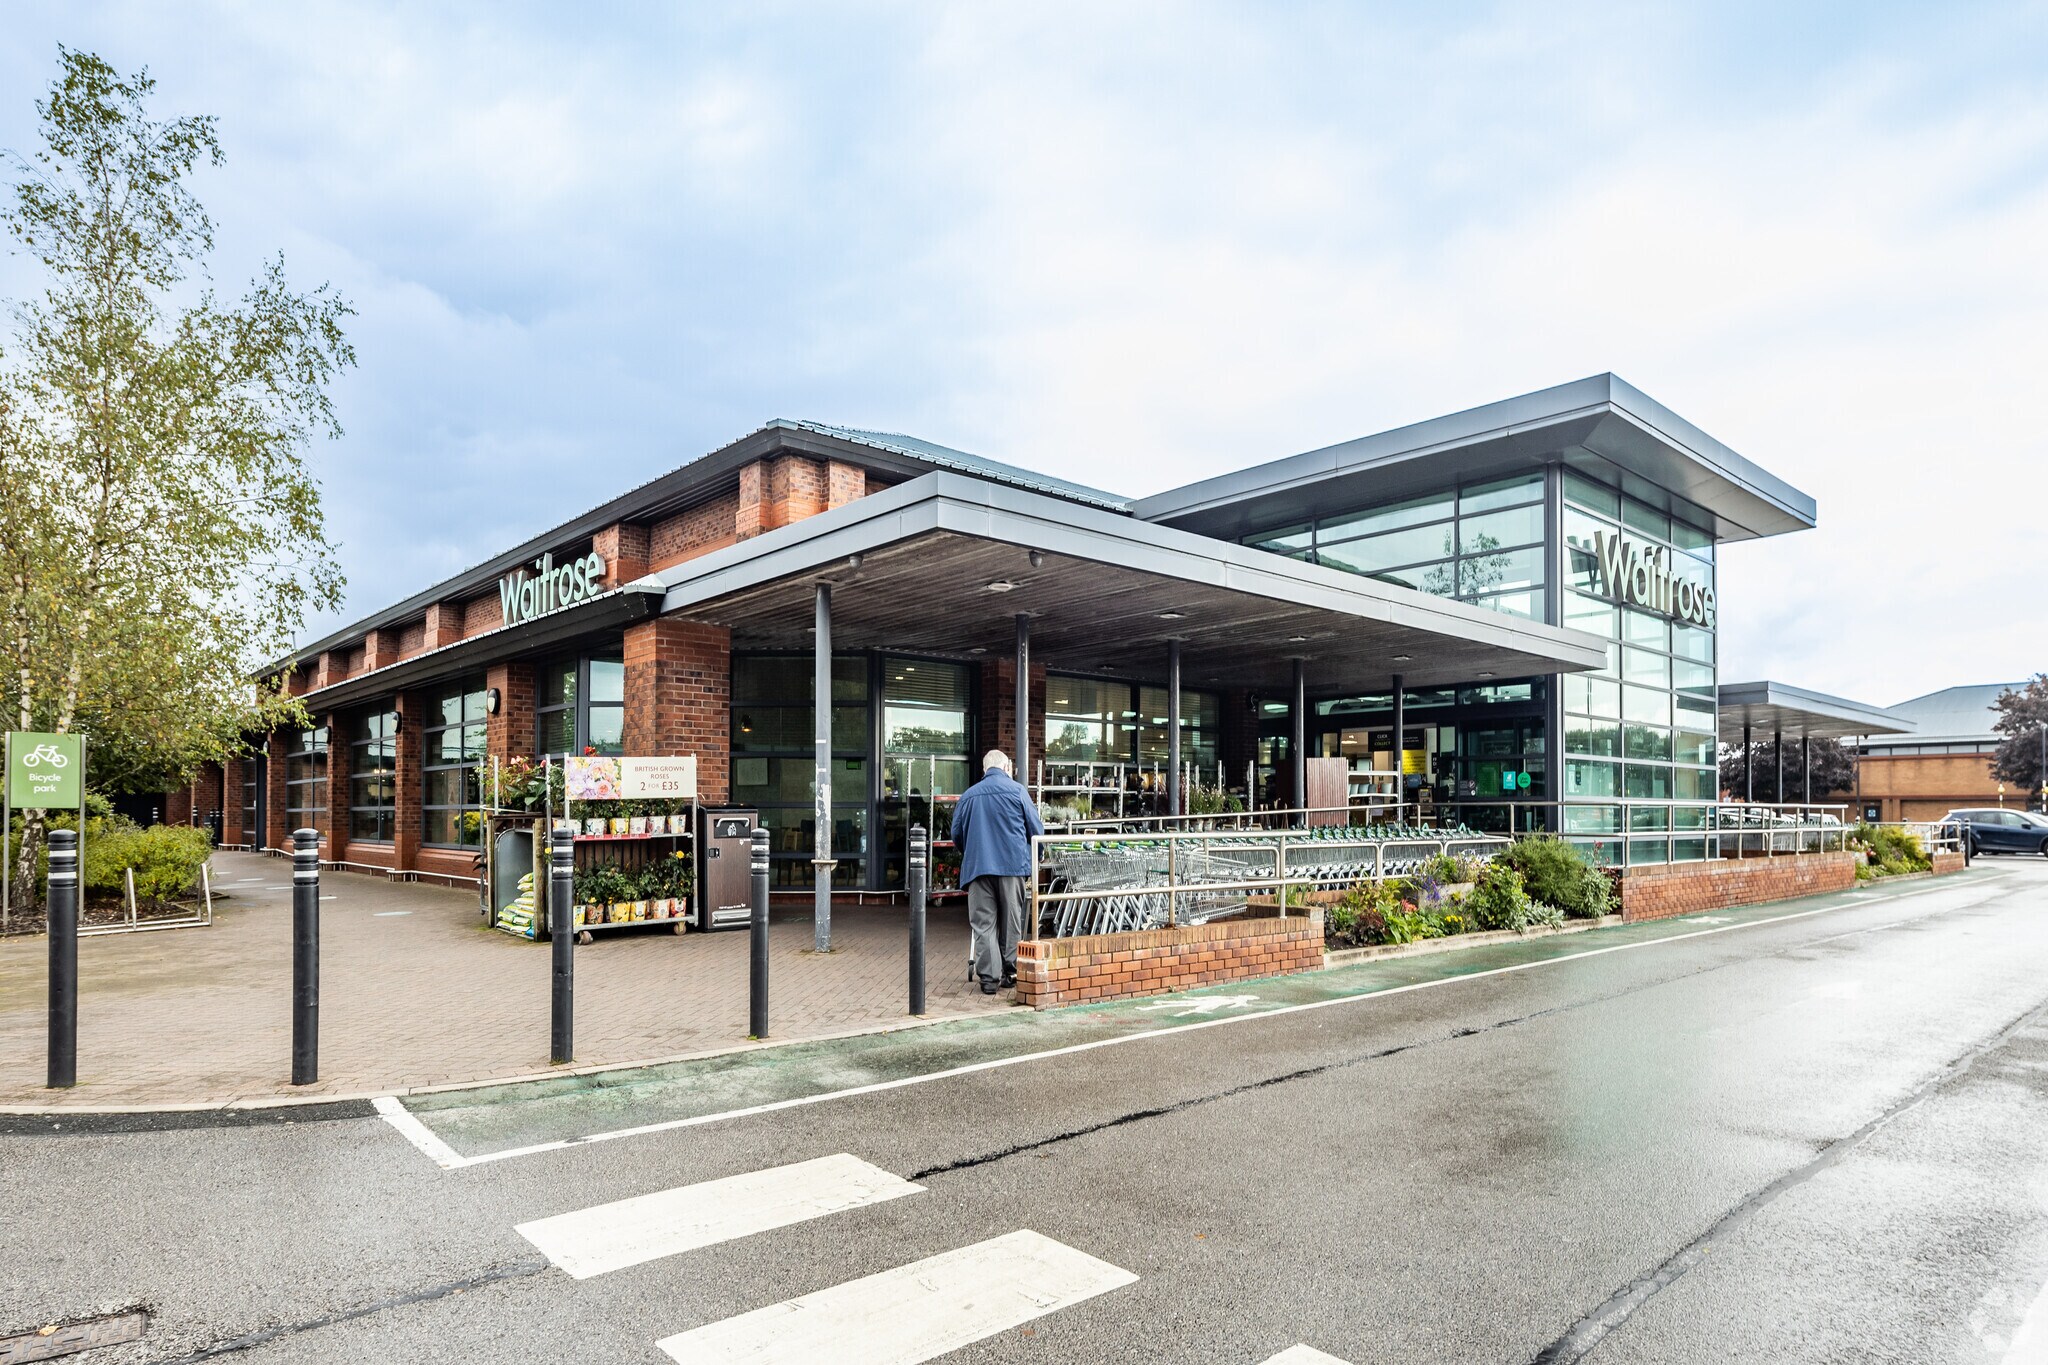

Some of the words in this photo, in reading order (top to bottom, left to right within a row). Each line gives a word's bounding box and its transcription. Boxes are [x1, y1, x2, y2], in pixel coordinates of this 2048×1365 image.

[1594, 530, 1716, 629] Waitrose
[499, 552, 605, 625] Waitrose
[28, 773, 62, 784] Bicycle
[33, 784, 57, 794] park
[640, 781, 646, 791] 2
[662, 781, 679, 791] £35
